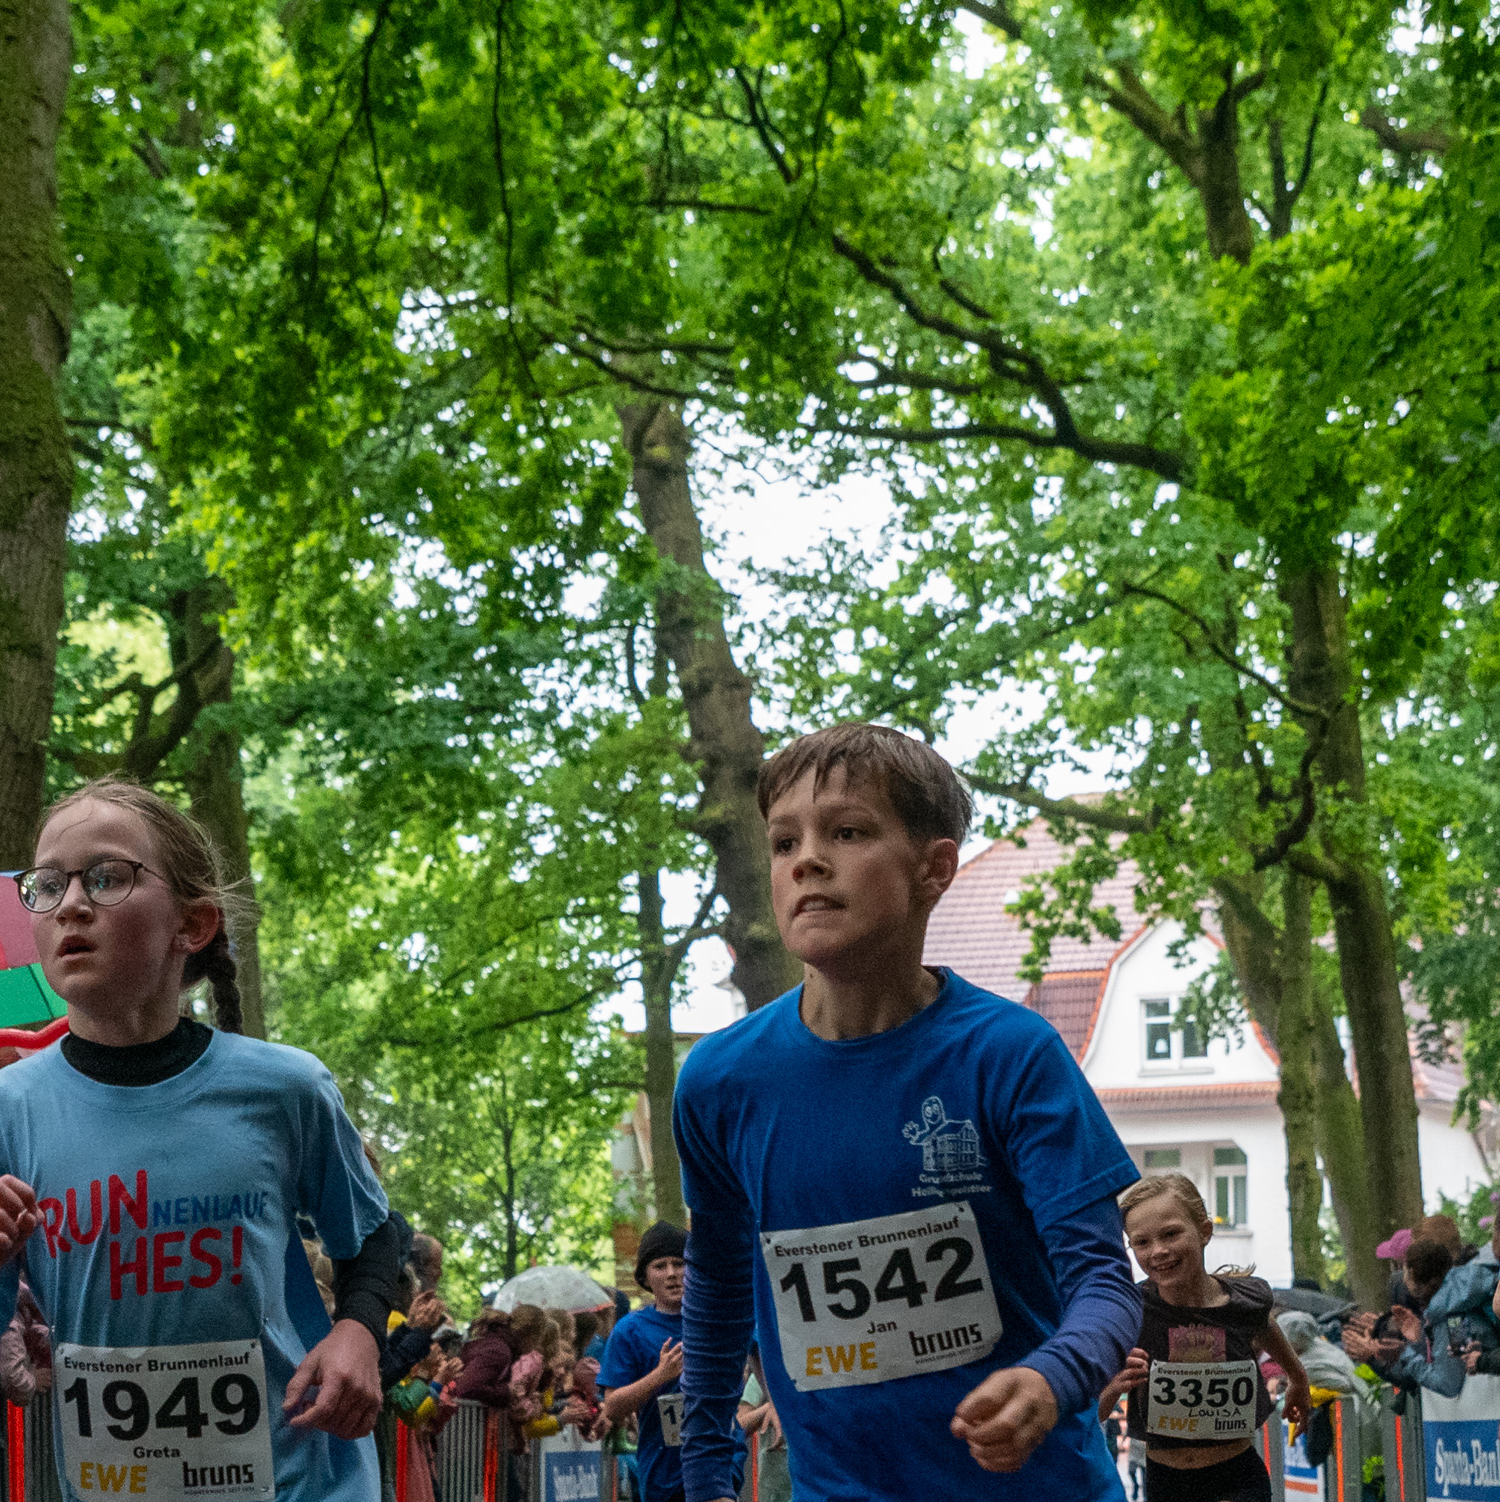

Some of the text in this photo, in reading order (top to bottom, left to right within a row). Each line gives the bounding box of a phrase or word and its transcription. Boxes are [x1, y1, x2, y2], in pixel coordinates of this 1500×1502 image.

[774, 1216, 960, 1258] Everstener Brunnenlauf
[109, 1226, 243, 1300] HES!
[779, 1236, 985, 1323] 1542
[867, 1320, 897, 1335] Jan
[64, 1352, 250, 1374] Everstener Brunnenlauf
[805, 1341, 878, 1377] EWE
[908, 1323, 983, 1357] bruns
[1157, 1367, 1202, 1376] Everstener
[64, 1373, 261, 1441] 1949
[1152, 1376, 1254, 1408] 3350
[1157, 1415, 1248, 1432] EWE bruns
[133, 1446, 181, 1459] Greta
[80, 1461, 255, 1494] EWE bruns
